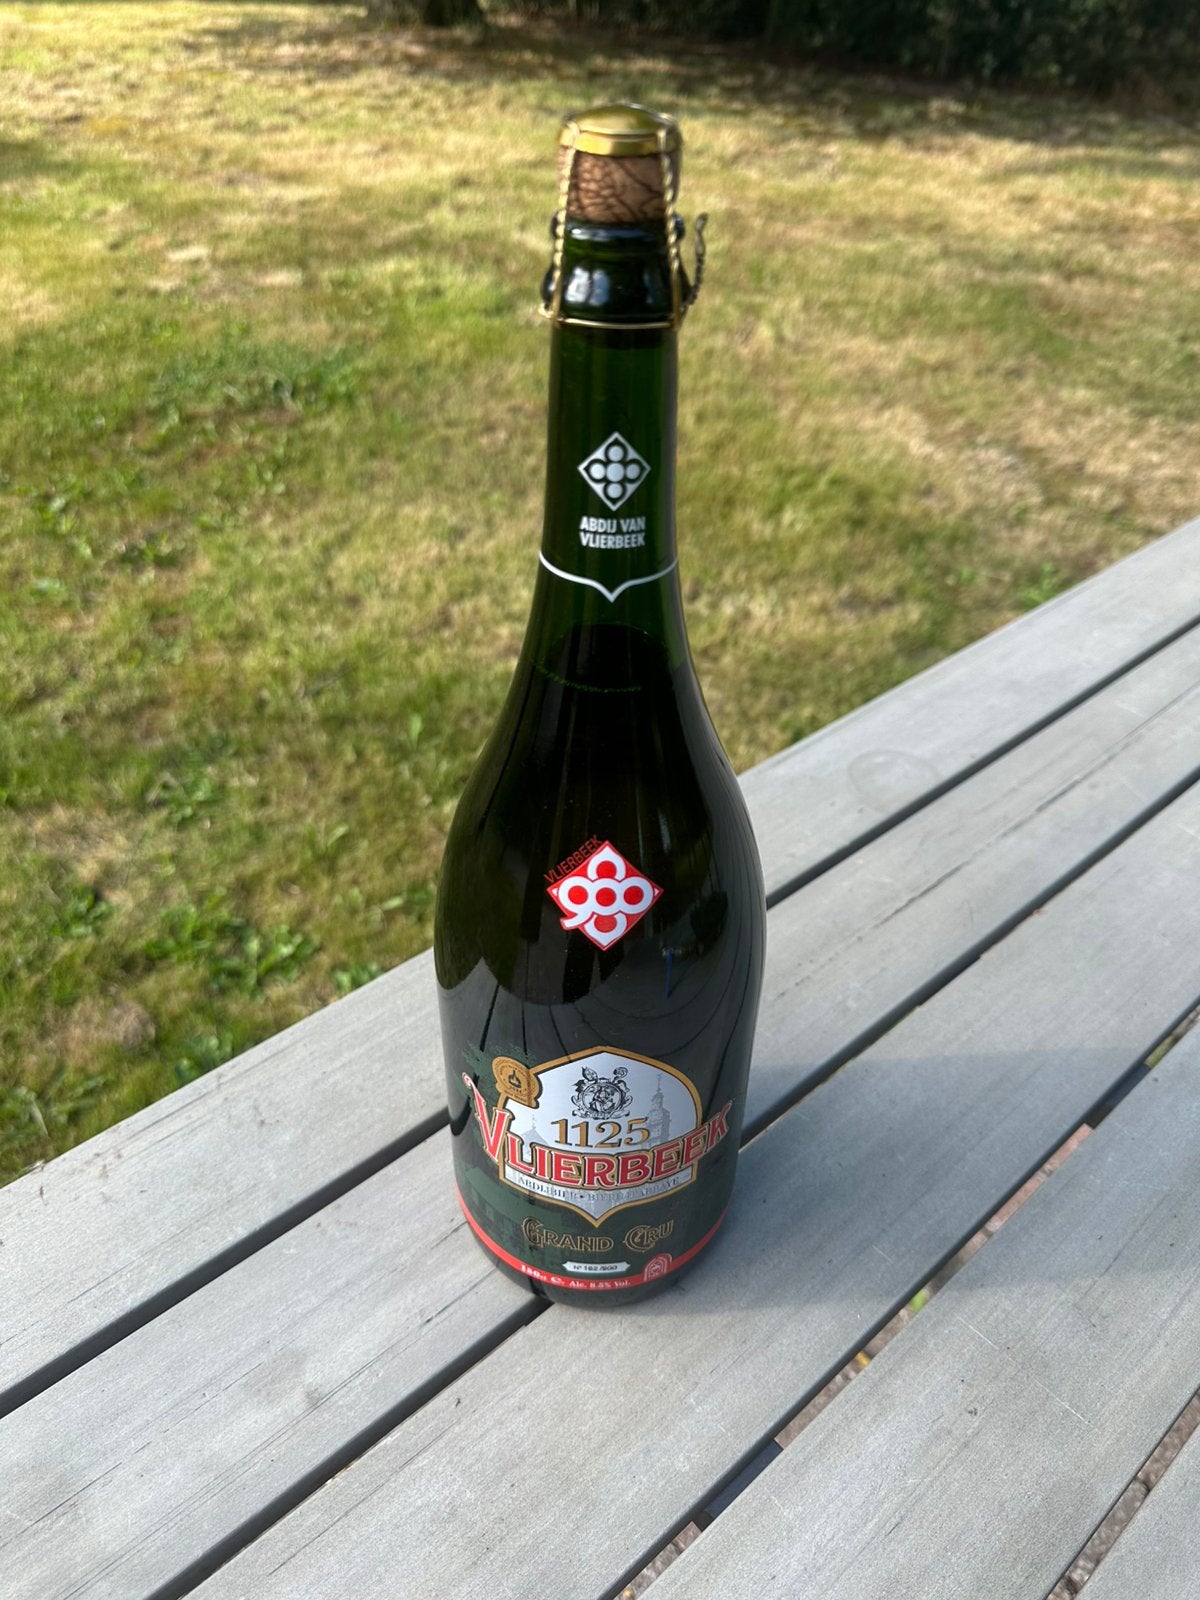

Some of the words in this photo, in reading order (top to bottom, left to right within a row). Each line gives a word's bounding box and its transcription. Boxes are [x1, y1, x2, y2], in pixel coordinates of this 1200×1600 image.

[579, 515, 616, 533] ABDIJ
[620, 516, 646, 532] VAN
[579, 532, 645, 549] VLIERBEEK
[543, 834, 603, 884] VLIERBEEK
[461, 1072, 733, 1189] VLIERBEEK
[551, 1116, 651, 1149] 1125
[521, 1216, 614, 1252] GRAND
[622, 1219, 674, 1253] CRU
